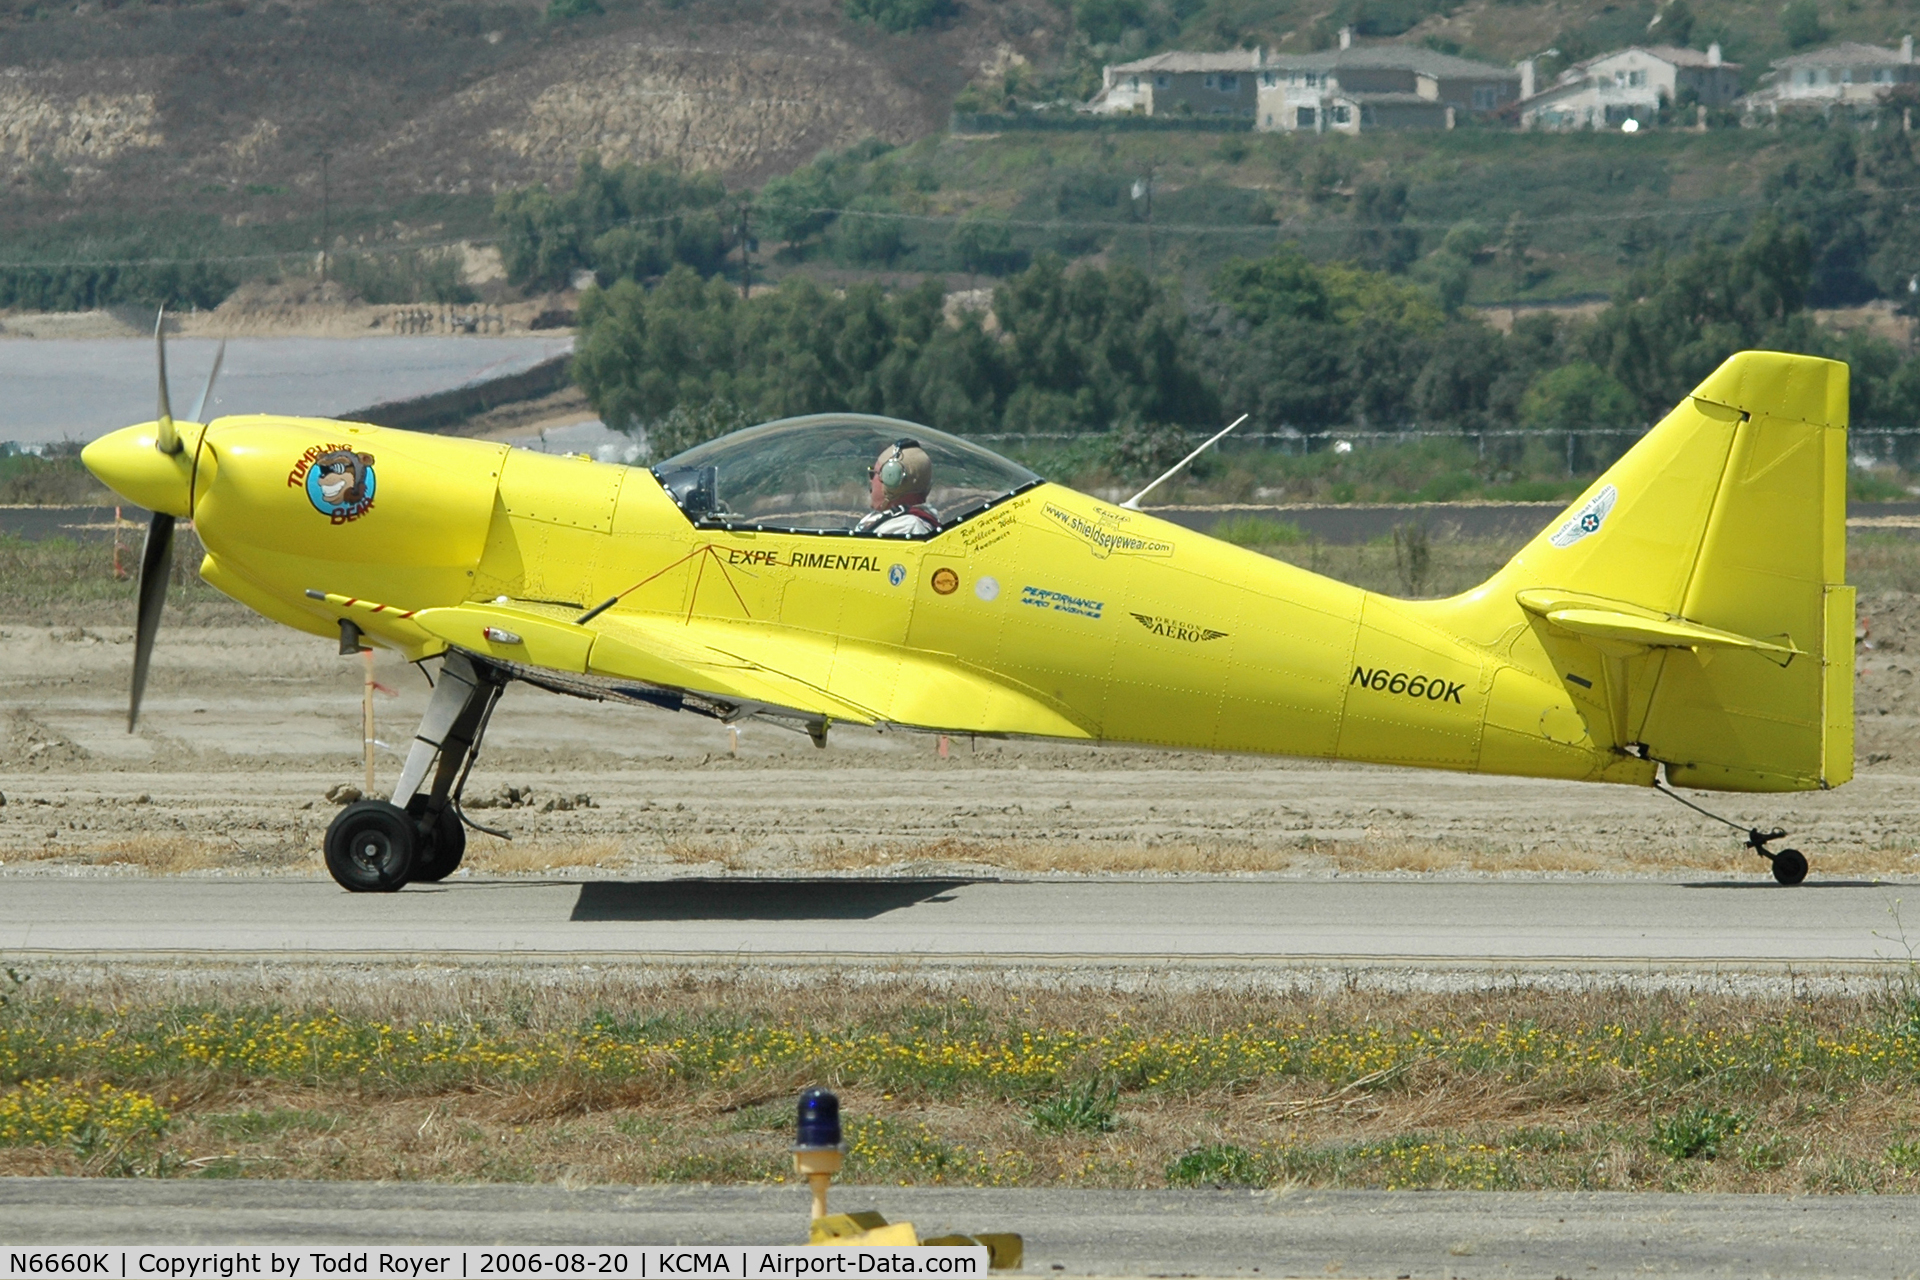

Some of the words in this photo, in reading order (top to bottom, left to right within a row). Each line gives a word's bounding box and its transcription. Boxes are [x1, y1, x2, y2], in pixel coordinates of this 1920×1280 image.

[287, 443, 353, 488] TUMBLING
[330, 497, 375, 526] BEAR
[1045, 504, 1170, 553] www.shieldseyewear.com
[1022, 586, 1104, 610] PERFORMANCE
[1152, 623, 1200, 643] AERO
[1155, 616, 1202, 631] OREGON
[1350, 666, 1466, 705] N6660K
